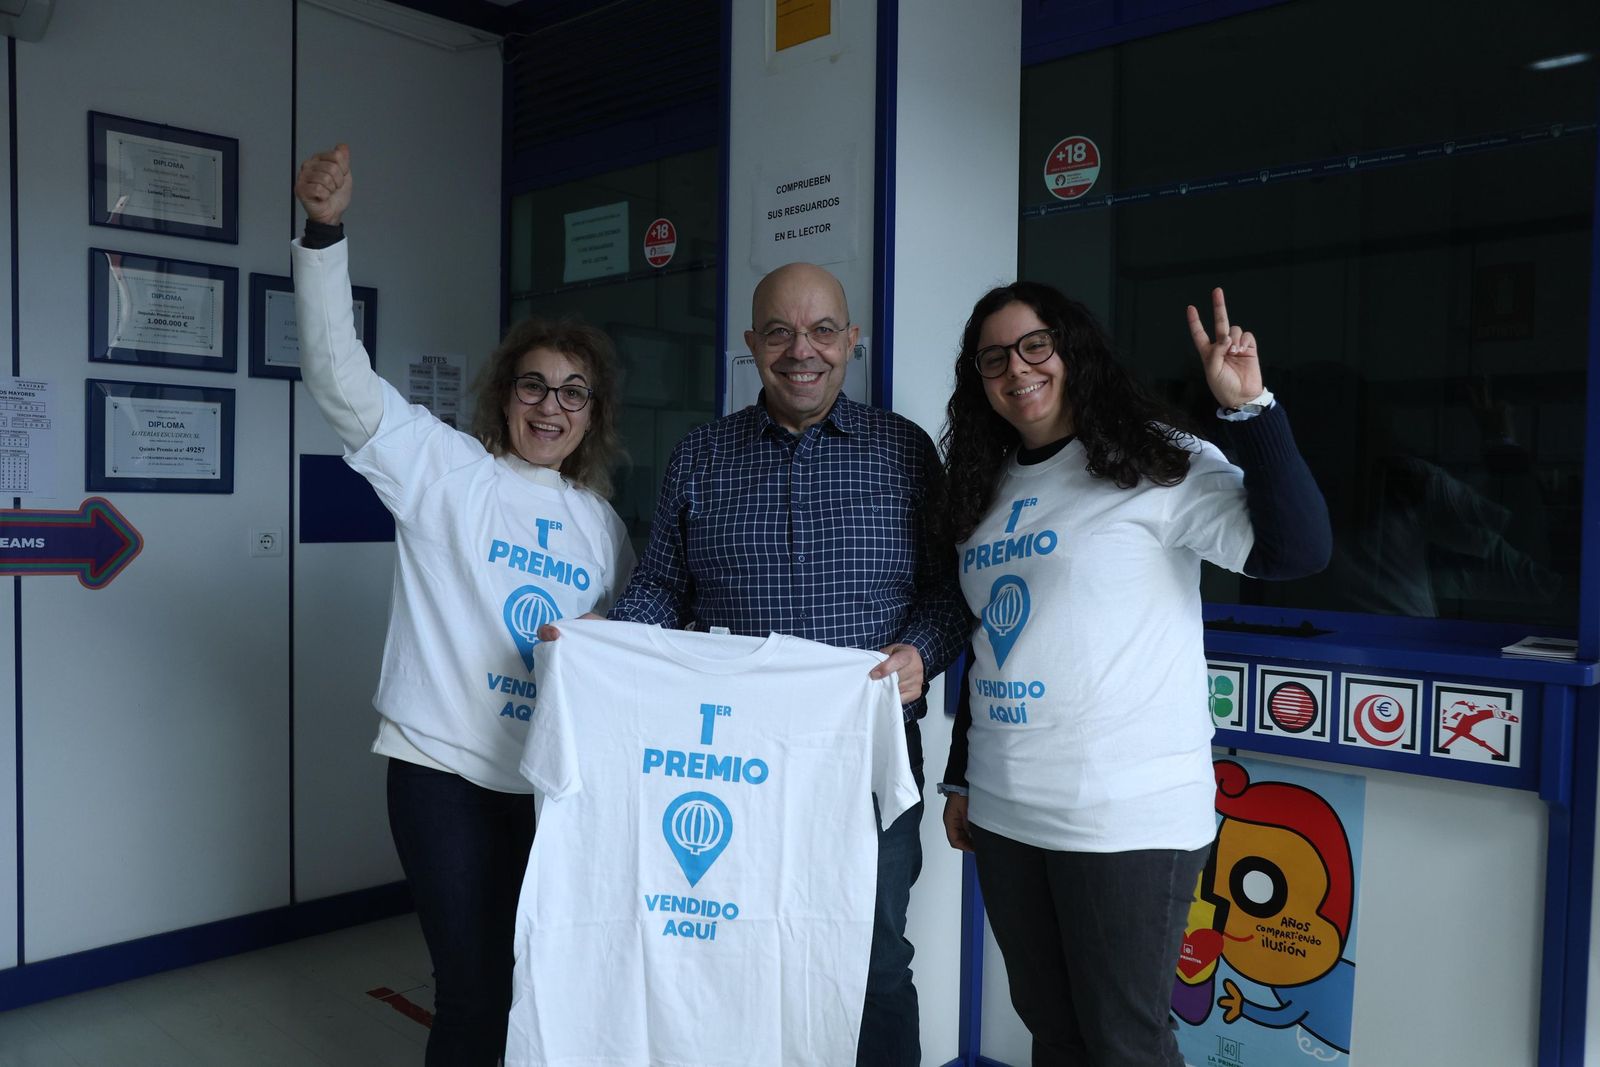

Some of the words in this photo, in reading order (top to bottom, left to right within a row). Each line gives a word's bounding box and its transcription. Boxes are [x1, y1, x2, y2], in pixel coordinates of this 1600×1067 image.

[1056, 142, 1087, 164] +18
[153, 159, 185, 170] DIPLOMA
[776, 174, 831, 195] COMPRUEBEN
[767, 209, 783, 220] SUS
[784, 196, 840, 216] RESGUARDOS
[650, 223, 669, 240] +18
[774, 231, 786, 242] EN
[787, 230, 797, 239] EL
[799, 223, 831, 237] LECTOR
[151, 292, 182, 302] DIPLOMA
[147, 318, 182, 327] 1.000.000
[422, 355, 447, 364] BOTES
[148, 421, 185, 429] DIPLOMA
[0, 537, 46, 548] EAMS
[963, 530, 1058, 574] PREMIO
[488, 539, 590, 591] PREMIO
[975, 678, 1045, 699] VENDIDO
[500, 701, 535, 722] AQ
[989, 701, 1027, 724] AQUÍ
[642, 748, 769, 785] PREMIO
[644, 894, 739, 920] VENDIDO
[662, 919, 718, 941] AQUÍ
[1280, 916, 1311, 932] AÑOS
